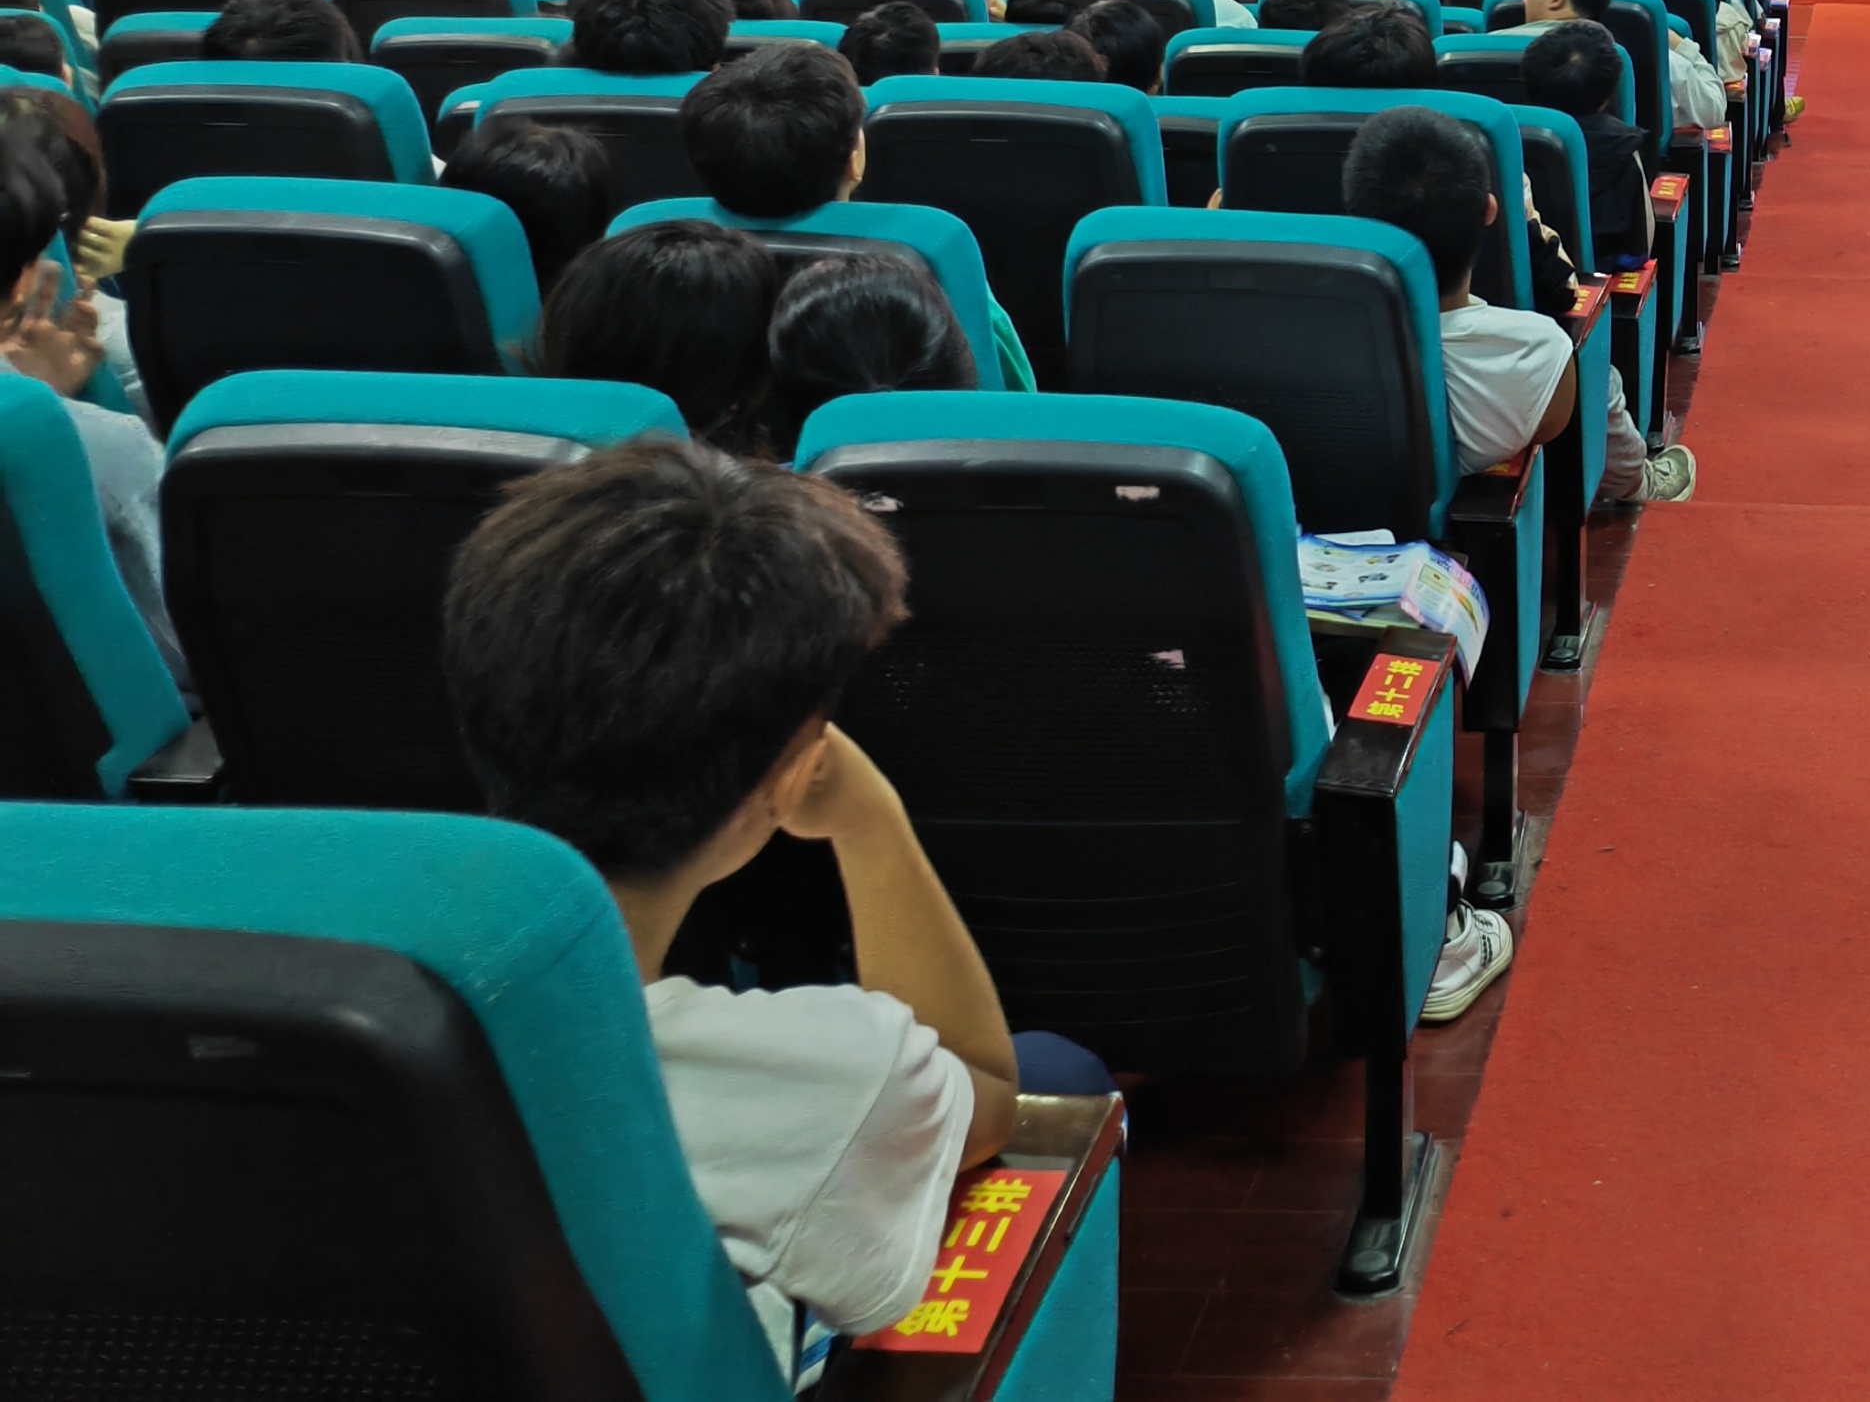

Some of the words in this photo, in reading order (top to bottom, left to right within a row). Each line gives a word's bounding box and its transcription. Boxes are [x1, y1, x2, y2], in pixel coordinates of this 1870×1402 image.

[1364, 659, 1424, 719] 第十二排
[893, 1178, 1033, 1338] 第十三排
